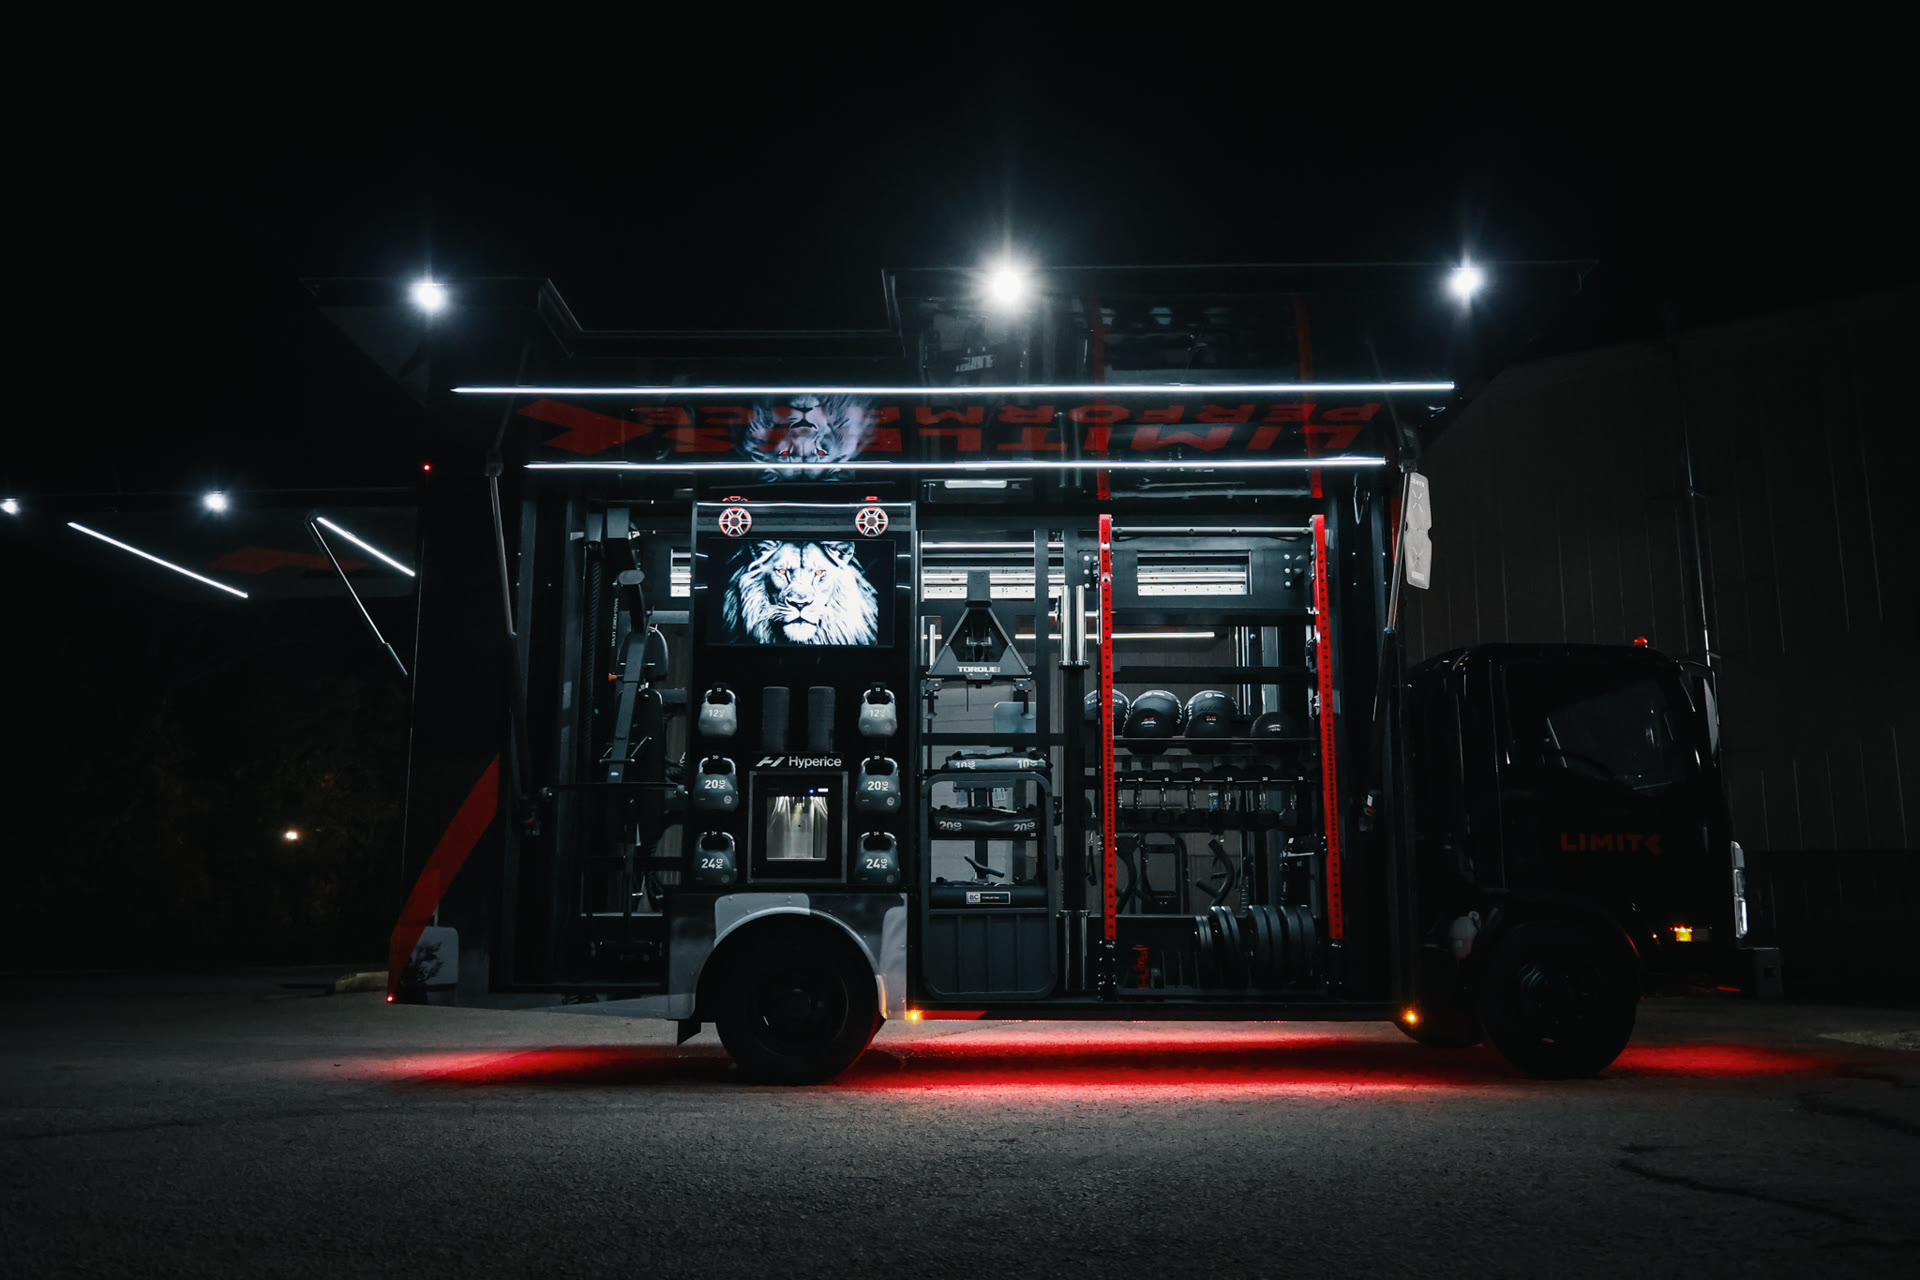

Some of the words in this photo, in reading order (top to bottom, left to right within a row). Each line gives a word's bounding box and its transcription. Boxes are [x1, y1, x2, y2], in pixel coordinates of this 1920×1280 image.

[632, 403, 1379, 425] PERFORMACE
[709, 709, 719, 717] 12
[869, 709, 879, 718] 12
[788, 755, 842, 769] Hyperice
[704, 779, 719, 790] 20
[867, 780, 881, 791] 20
[939, 821, 954, 831] 20
[1013, 822, 1027, 832] 20
[701, 858, 716, 869] 24
[866, 858, 880, 869] 24
